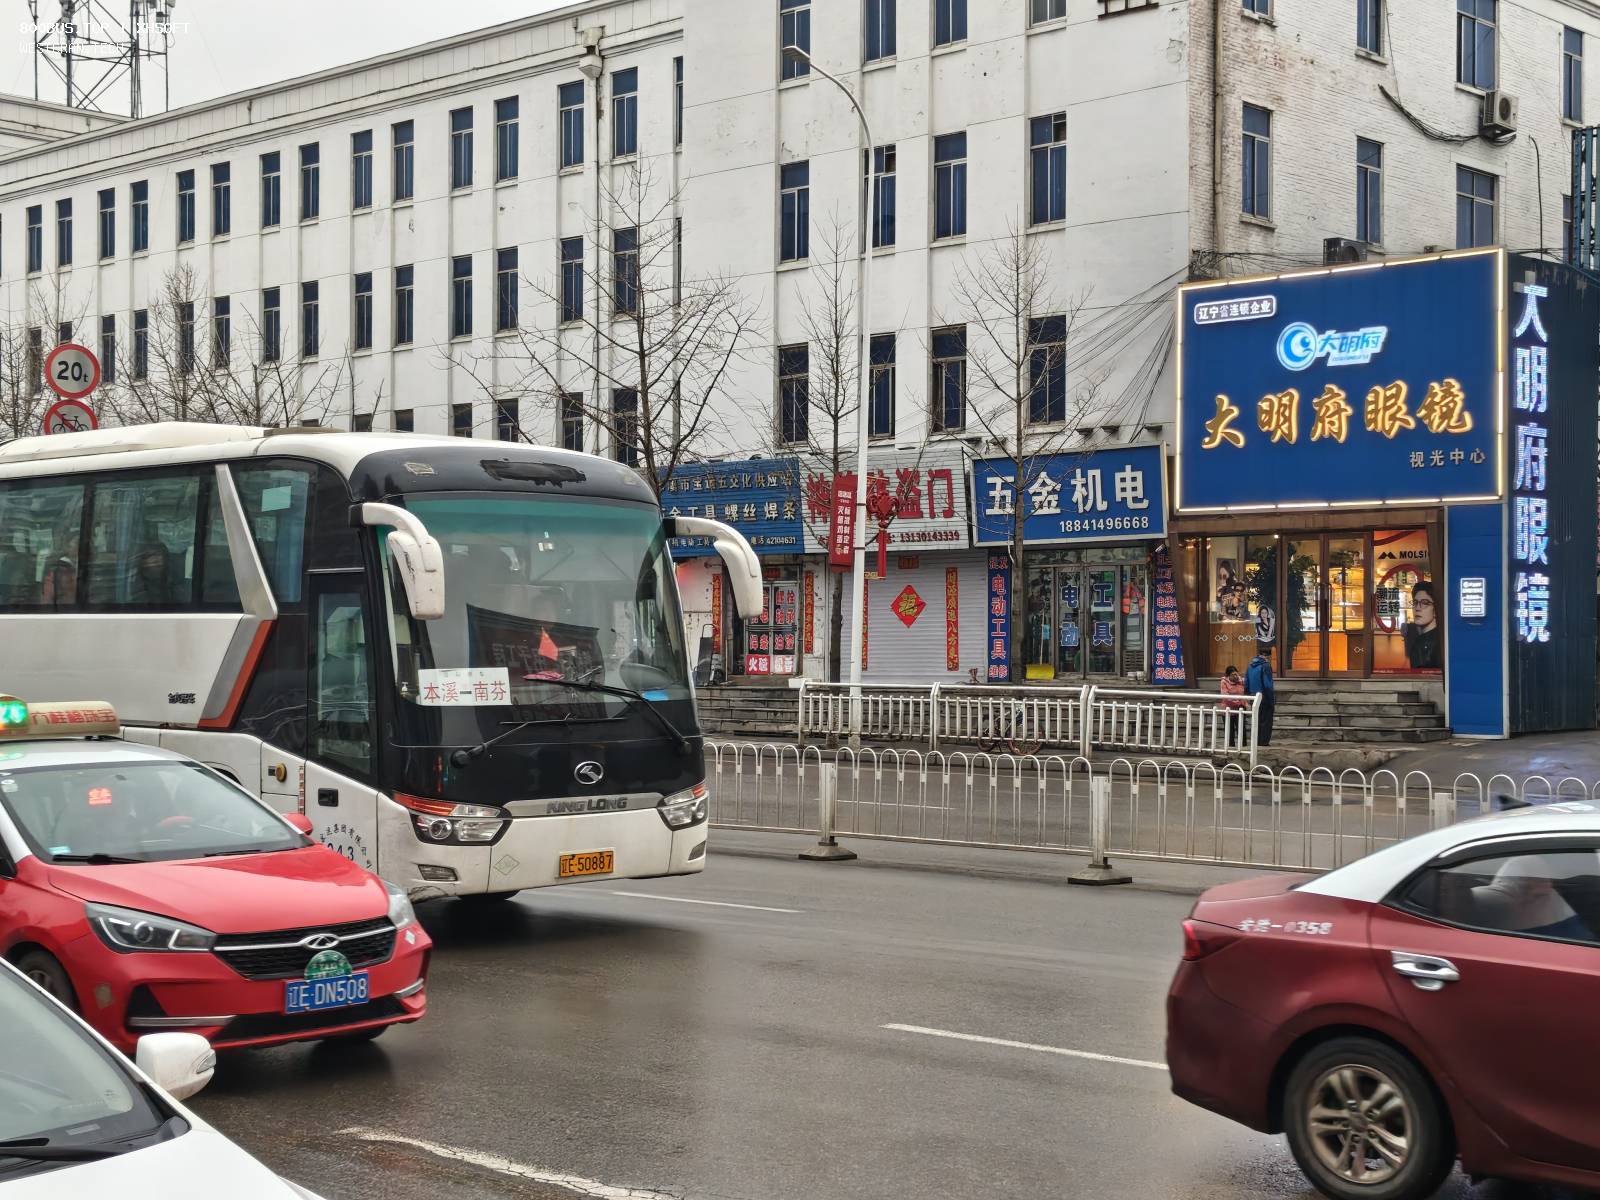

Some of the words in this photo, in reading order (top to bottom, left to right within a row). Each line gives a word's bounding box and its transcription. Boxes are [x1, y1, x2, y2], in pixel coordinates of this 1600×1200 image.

[1198, 299, 1272, 321] 辽宁省连锁企业
[1318, 331, 1383, 354] 大明府
[1200, 377, 1475, 450] 大明府眼镜
[1408, 447, 1486, 470] 视光中心
[1514, 272, 1551, 644] 大明府眼镜
[985, 464, 1150, 516] 五金机电
[1059, 516, 1150, 533] 18841496668
[991, 576, 1007, 660] 电动工具
